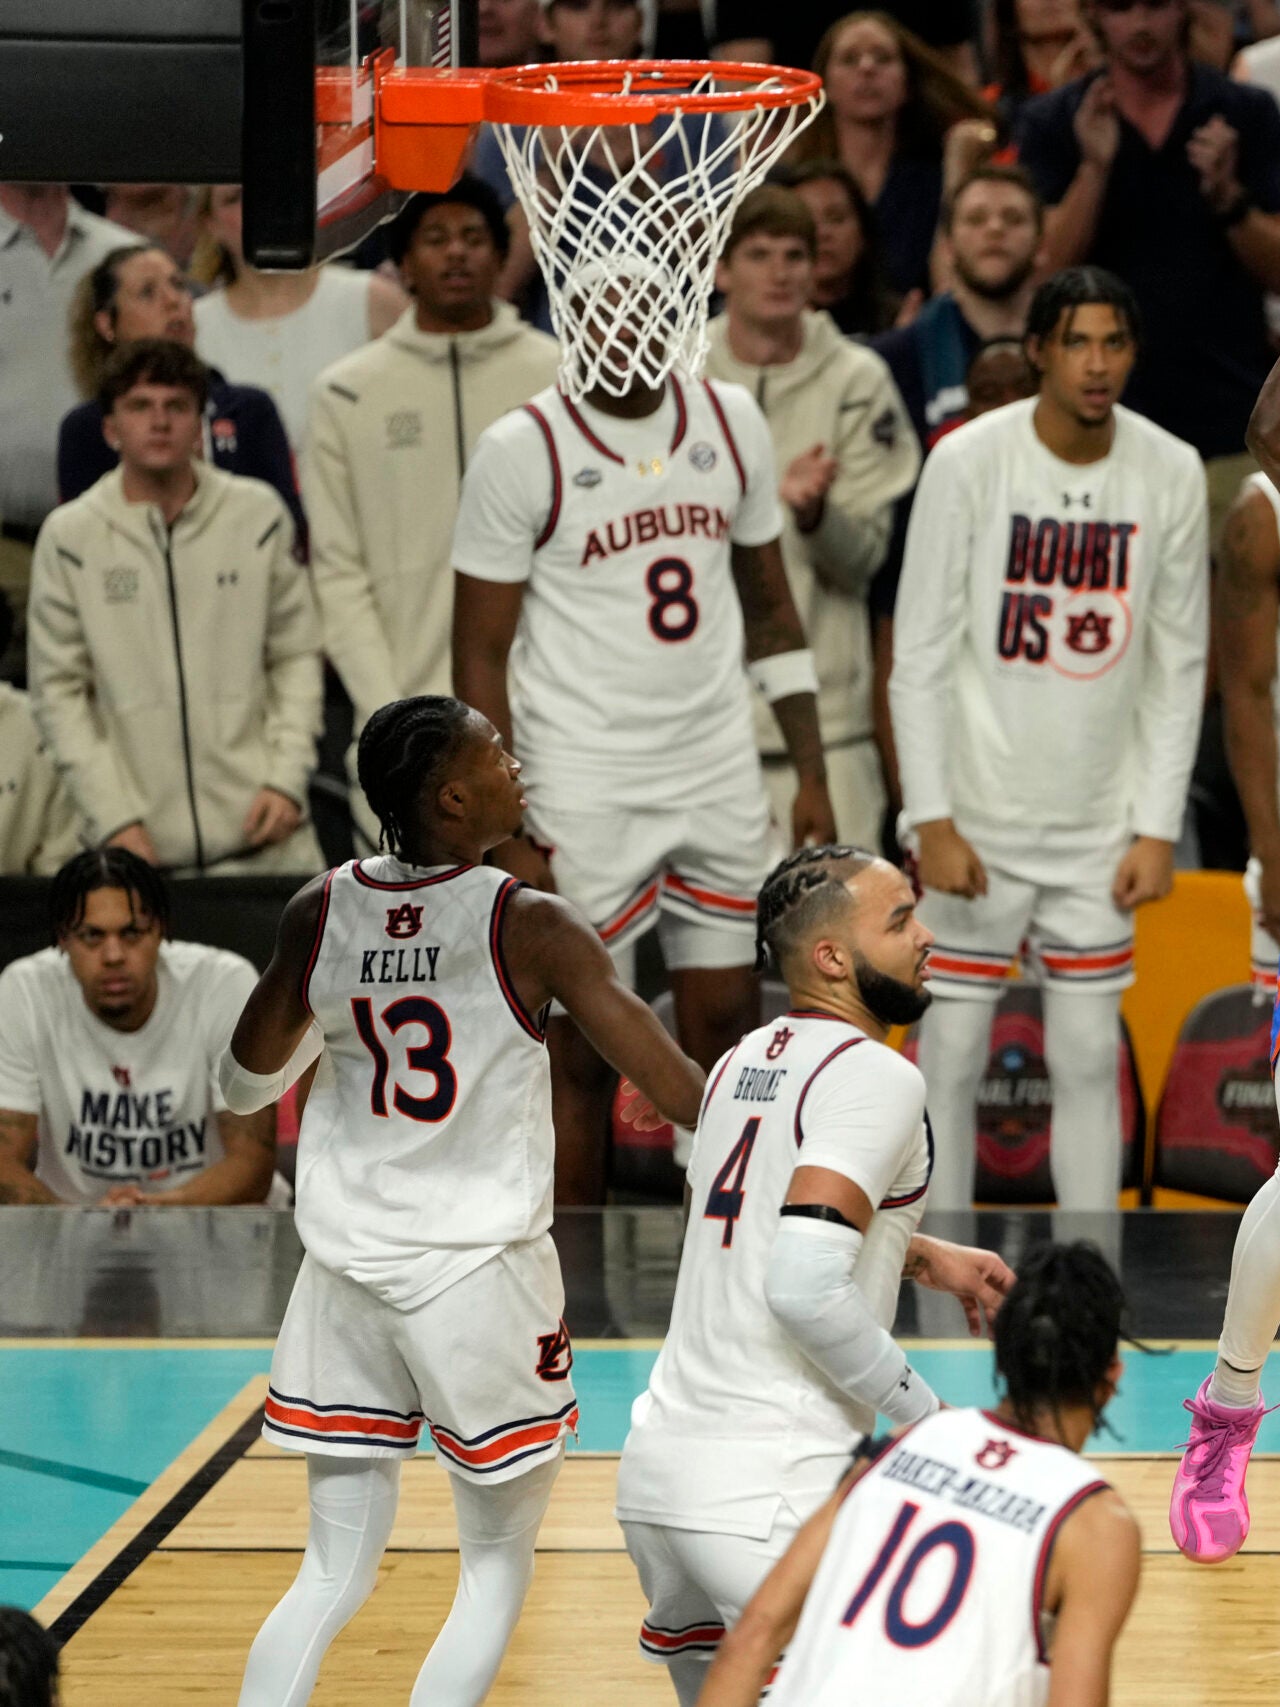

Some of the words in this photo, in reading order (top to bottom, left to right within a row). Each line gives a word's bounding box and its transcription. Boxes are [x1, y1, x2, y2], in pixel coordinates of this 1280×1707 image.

[1007, 514, 1137, 592] DOUBT
[645, 557, 700, 644] 8
[999, 592, 1052, 664] US
[360, 947, 440, 983] KELLY
[350, 996, 458, 1123] 13
[66, 1118, 207, 1168] HISTORY
[82, 1090, 174, 1129] MAKE
[703, 1117, 762, 1248] 4
[840, 1501, 977, 1650] 10
